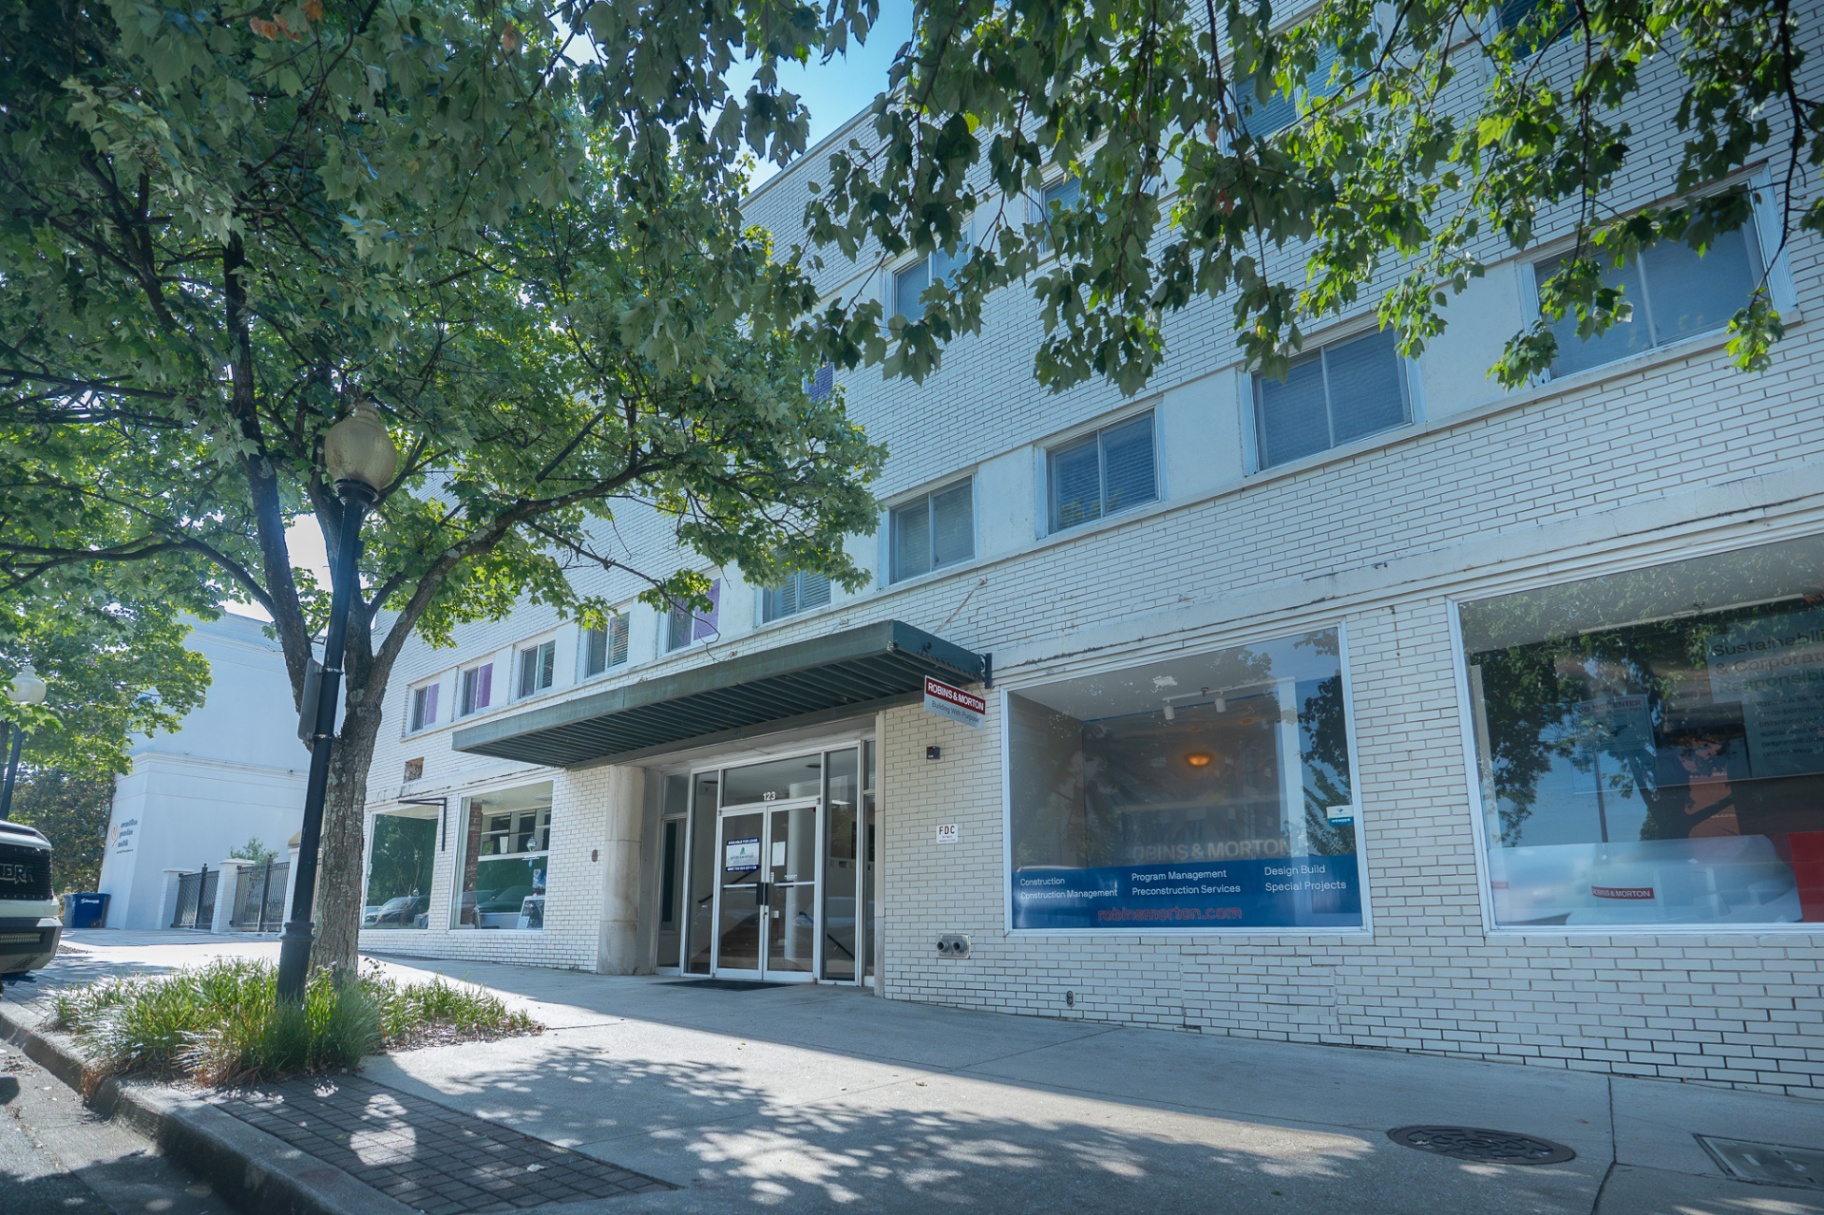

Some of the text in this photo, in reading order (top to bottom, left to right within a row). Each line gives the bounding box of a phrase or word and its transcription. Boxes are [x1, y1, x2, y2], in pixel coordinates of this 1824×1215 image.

[1734, 651, 1824, 673] Corporat
[928, 682, 984, 711] ROBINS & MORTON
[931, 700, 950, 715] Building
[763, 791, 776, 801] 123
[938, 825, 955, 835] FDC
[1131, 869, 1228, 883] Program Management
[1264, 864, 1326, 877] Design Build
[1020, 877, 1066, 887] Construction
[1265, 880, 1347, 893] Special Projects
[1020, 889, 1118, 900] Construction Management
[1132, 884, 1241, 896] Preconstruction Services
[1616, 890, 1651, 898] MORTON
[1097, 905, 1243, 921] robinsmorton.com
